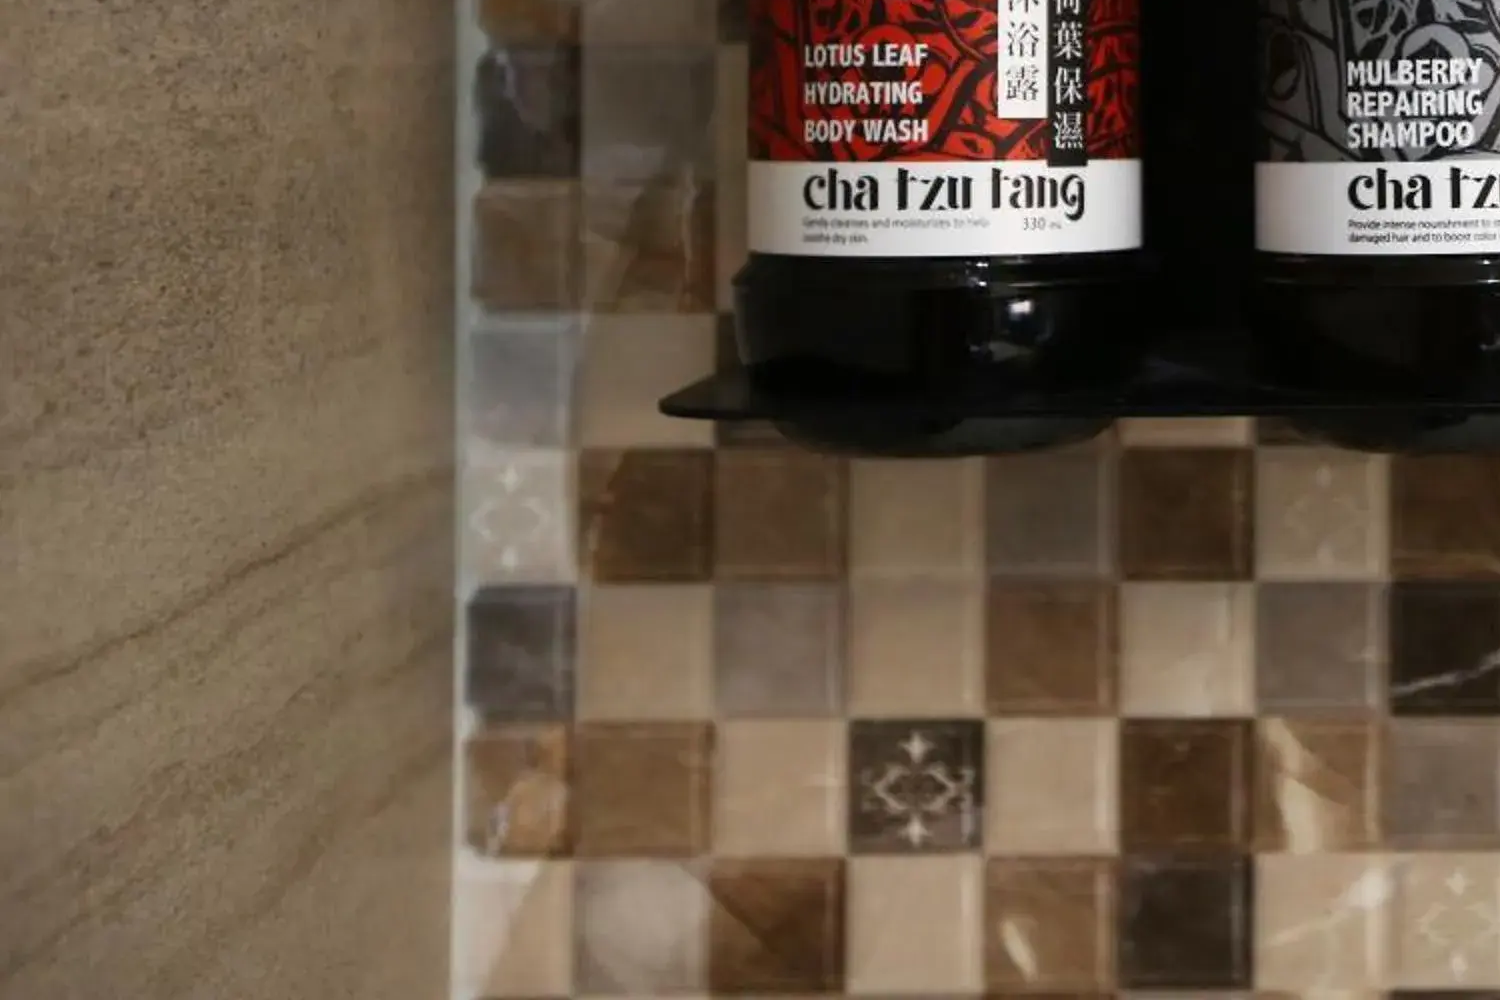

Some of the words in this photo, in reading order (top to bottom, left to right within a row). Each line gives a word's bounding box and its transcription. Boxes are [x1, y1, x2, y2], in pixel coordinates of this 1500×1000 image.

[804, 43, 866, 67] LOTUS
[873, 43, 928, 67] LEAF
[1347, 58, 1483, 86] MULBERRY
[804, 81, 923, 105] HYDRATING
[1347, 89, 1483, 118] REPAIRING
[804, 119, 856, 142] BODY
[863, 119, 929, 142] WASH
[1347, 120, 1475, 149] SHAMPOO
[803, 168, 878, 211] cha
[896, 168, 972, 211] tzu
[992, 168, 1085, 221] tang
[1348, 168, 1431, 210] cha
[872, 218, 890, 229] and
[1023, 216, 1046, 230] 330
[1411, 233, 1429, 242] and
[1431, 233, 1442, 242] to
